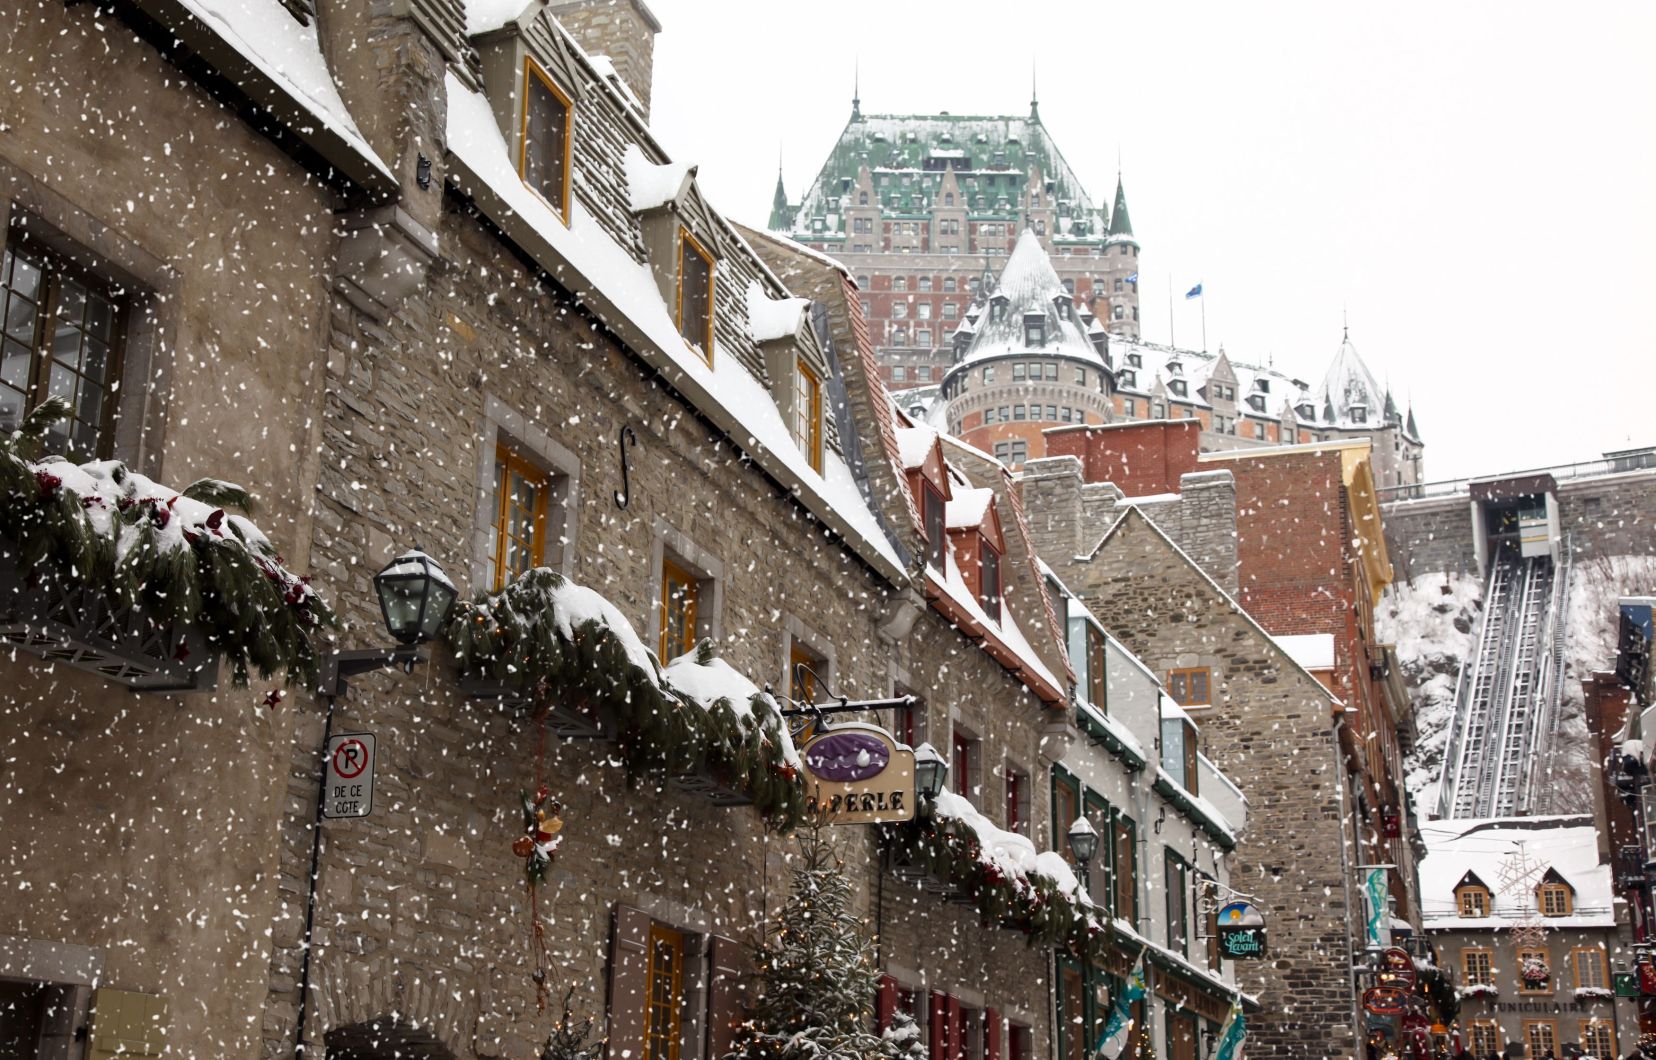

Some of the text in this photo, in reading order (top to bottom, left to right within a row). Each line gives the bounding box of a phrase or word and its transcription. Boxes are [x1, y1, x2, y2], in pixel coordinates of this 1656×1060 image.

[334, 784, 363, 798] DE CE
[831, 791, 905, 813] PERLE
[1227, 930, 1253, 944] Soleil
[1227, 941, 1258, 955] Levant
[1489, 1001, 1588, 1014] FUNICULAIRE
